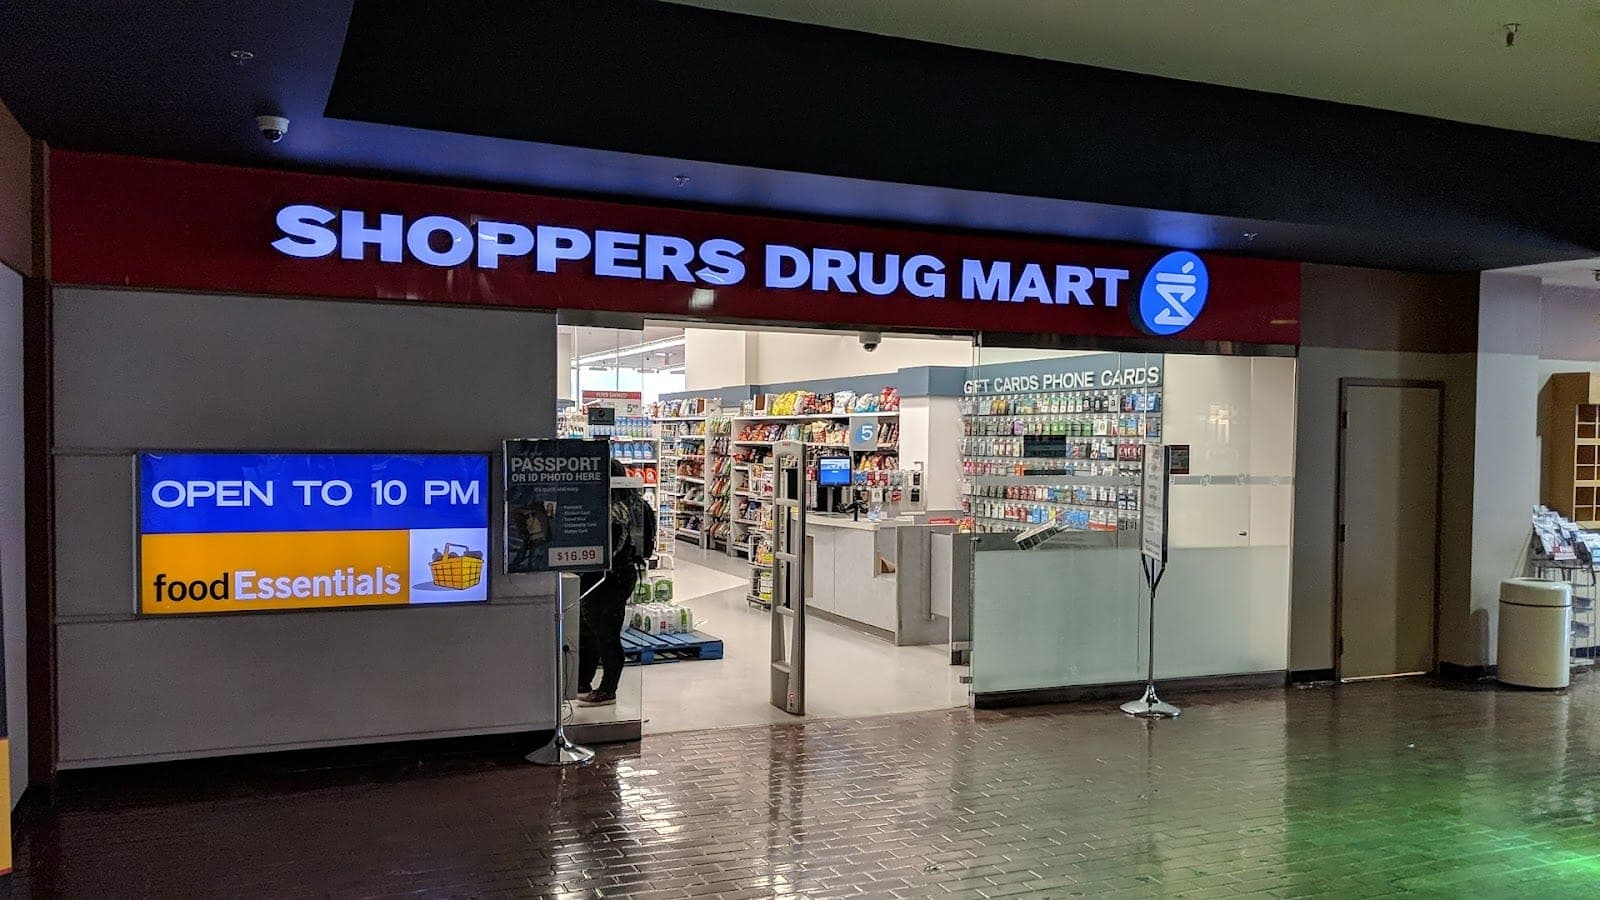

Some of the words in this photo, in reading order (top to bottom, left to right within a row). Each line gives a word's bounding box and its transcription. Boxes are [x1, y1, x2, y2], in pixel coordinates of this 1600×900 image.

[271, 204, 746, 286] SHOPPERS
[765, 244, 945, 298] DRUG
[962, 258, 1129, 307] MART
[963, 379, 990, 394] GFT
[993, 375, 1039, 393] CARDS
[1043, 371, 1095, 389] PHONE
[1100, 367, 1159, 387] CARDS
[861, 425, 873, 441] 5
[511, 457, 602, 472] PASSPORT
[511, 473, 526, 482] OR
[528, 473, 538, 482] ID
[540, 472, 574, 482] PHOTO
[575, 472, 602, 481] HERE
[152, 480, 274, 507] OPEN
[292, 479, 353, 506] TO
[371, 479, 407, 506] 10
[424, 479, 480, 505] PM
[556, 549, 597, 561] $16.99
[153, 572, 229, 602] food
[233, 566, 401, 601] Essentials
